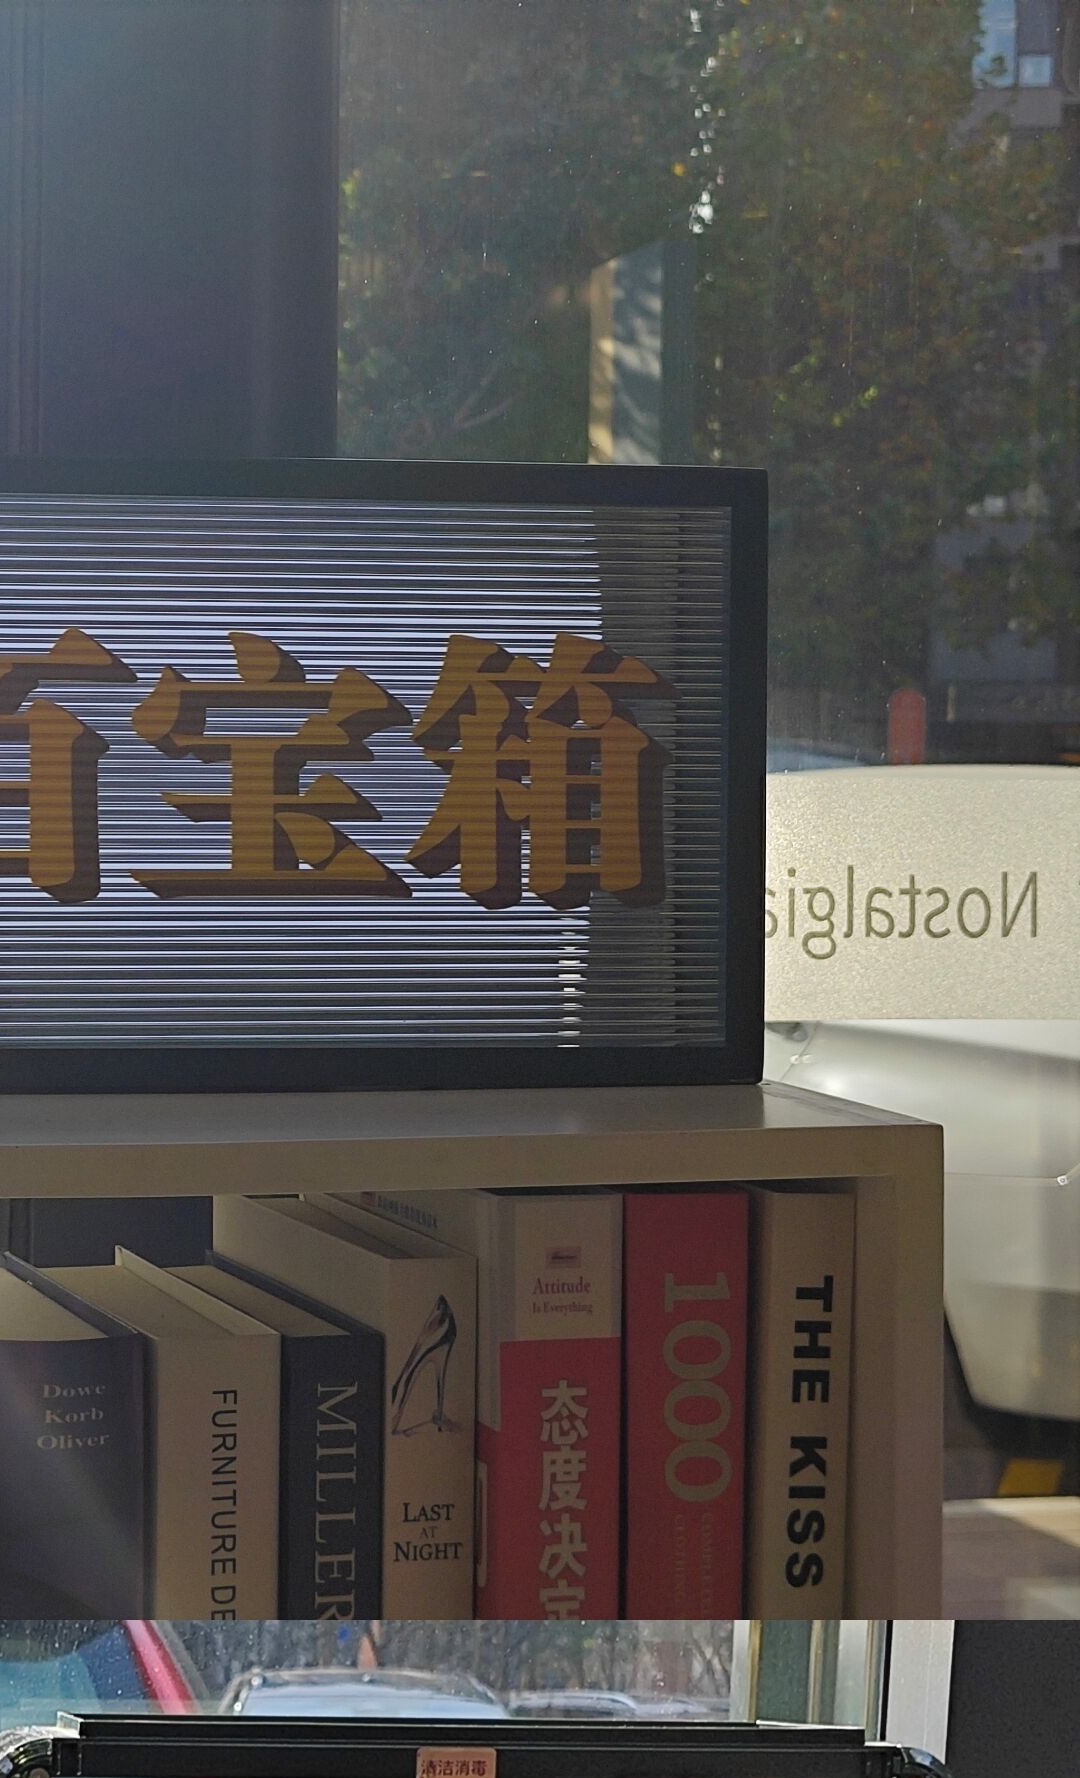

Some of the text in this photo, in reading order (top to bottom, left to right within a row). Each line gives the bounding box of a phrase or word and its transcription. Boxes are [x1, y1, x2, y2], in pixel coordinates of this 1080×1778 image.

[532, 1276, 591, 1294] Attitude
[662, 1271, 733, 1502] 1000
[45, 1407, 104, 1423] Korb
[36, 1434, 110, 1449] Oliver
[784, 1275, 834, 1588] THE KISS
[211, 1389, 237, 1576] FURNITURE
[315, 1381, 358, 1620] MILLER
[402, 1502, 456, 1523] LAST
[421, 1526, 438, 1539] AT
[393, 1541, 464, 1562] NIGHT
